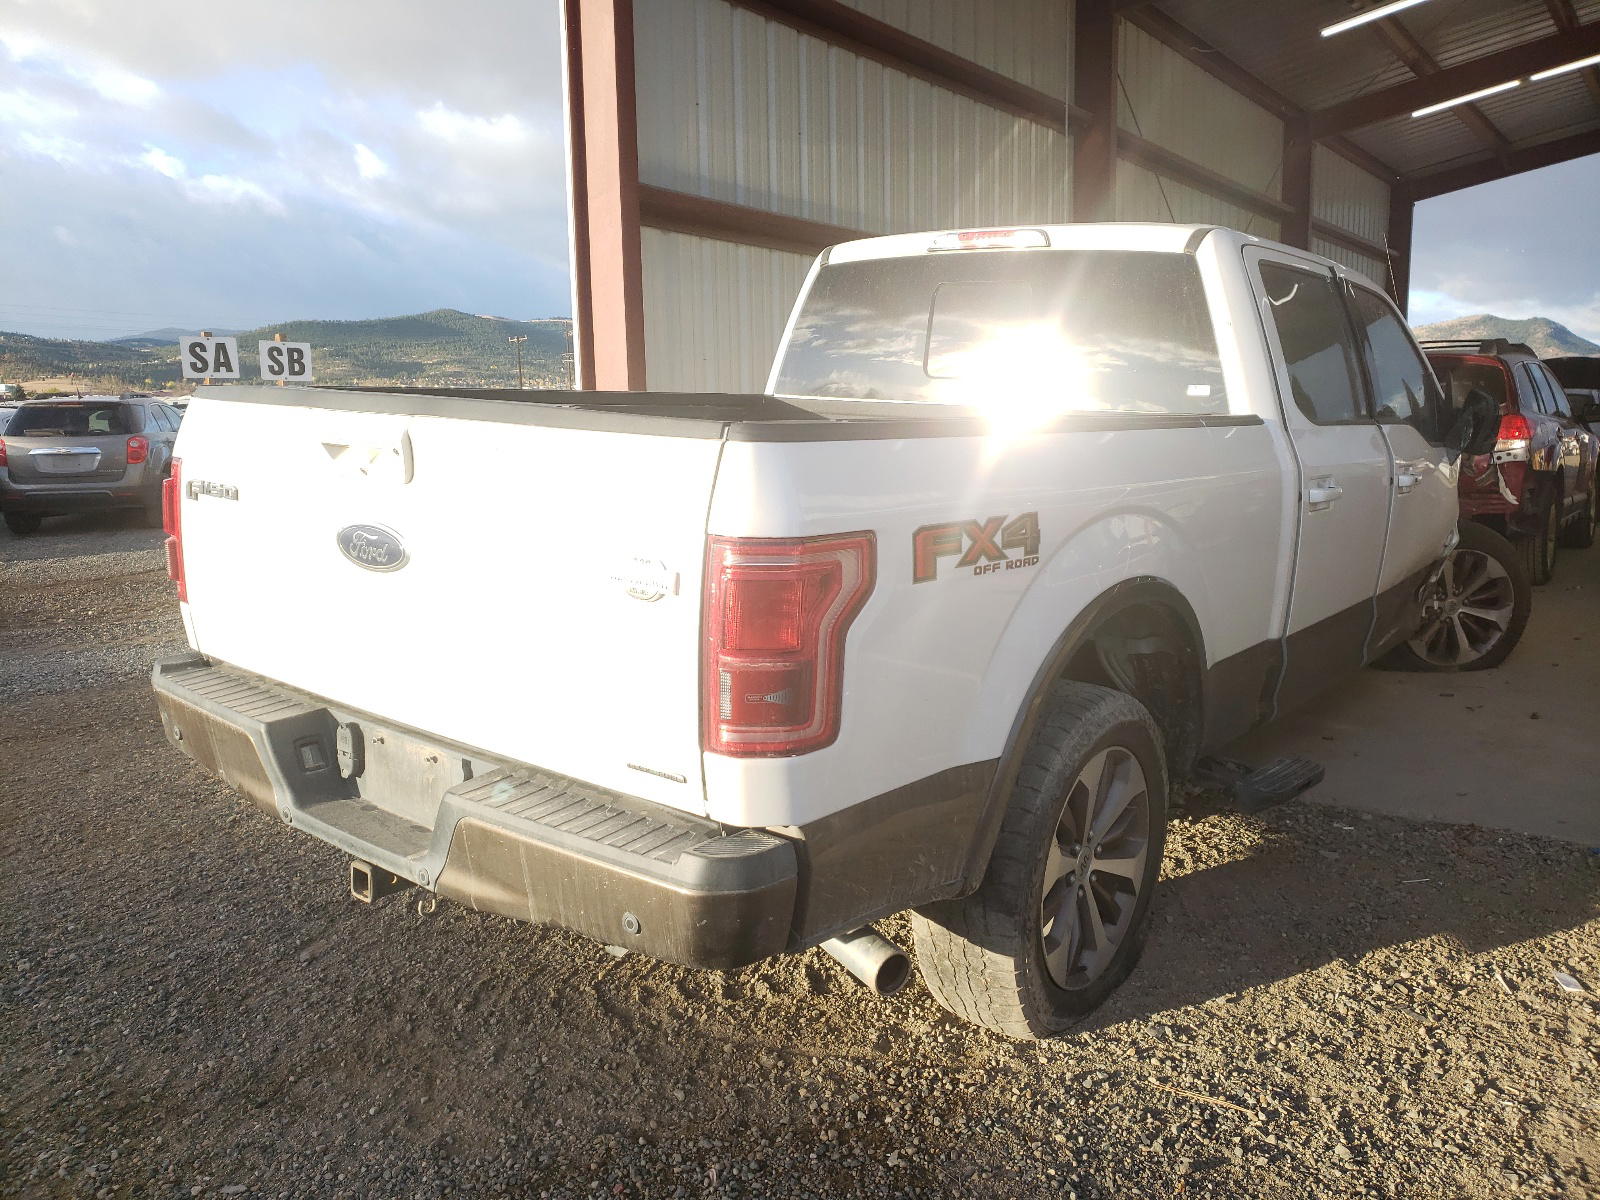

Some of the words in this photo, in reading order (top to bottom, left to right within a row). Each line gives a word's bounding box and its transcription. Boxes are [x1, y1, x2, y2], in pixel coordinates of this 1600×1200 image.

[188, 341, 234, 374] SA
[267, 345, 306, 376] SB
[349, 530, 390, 563] Ford
[911, 511, 1041, 585] FX4
[973, 562, 1001, 576] OFF
[1005, 556, 1040, 571] ROAD
